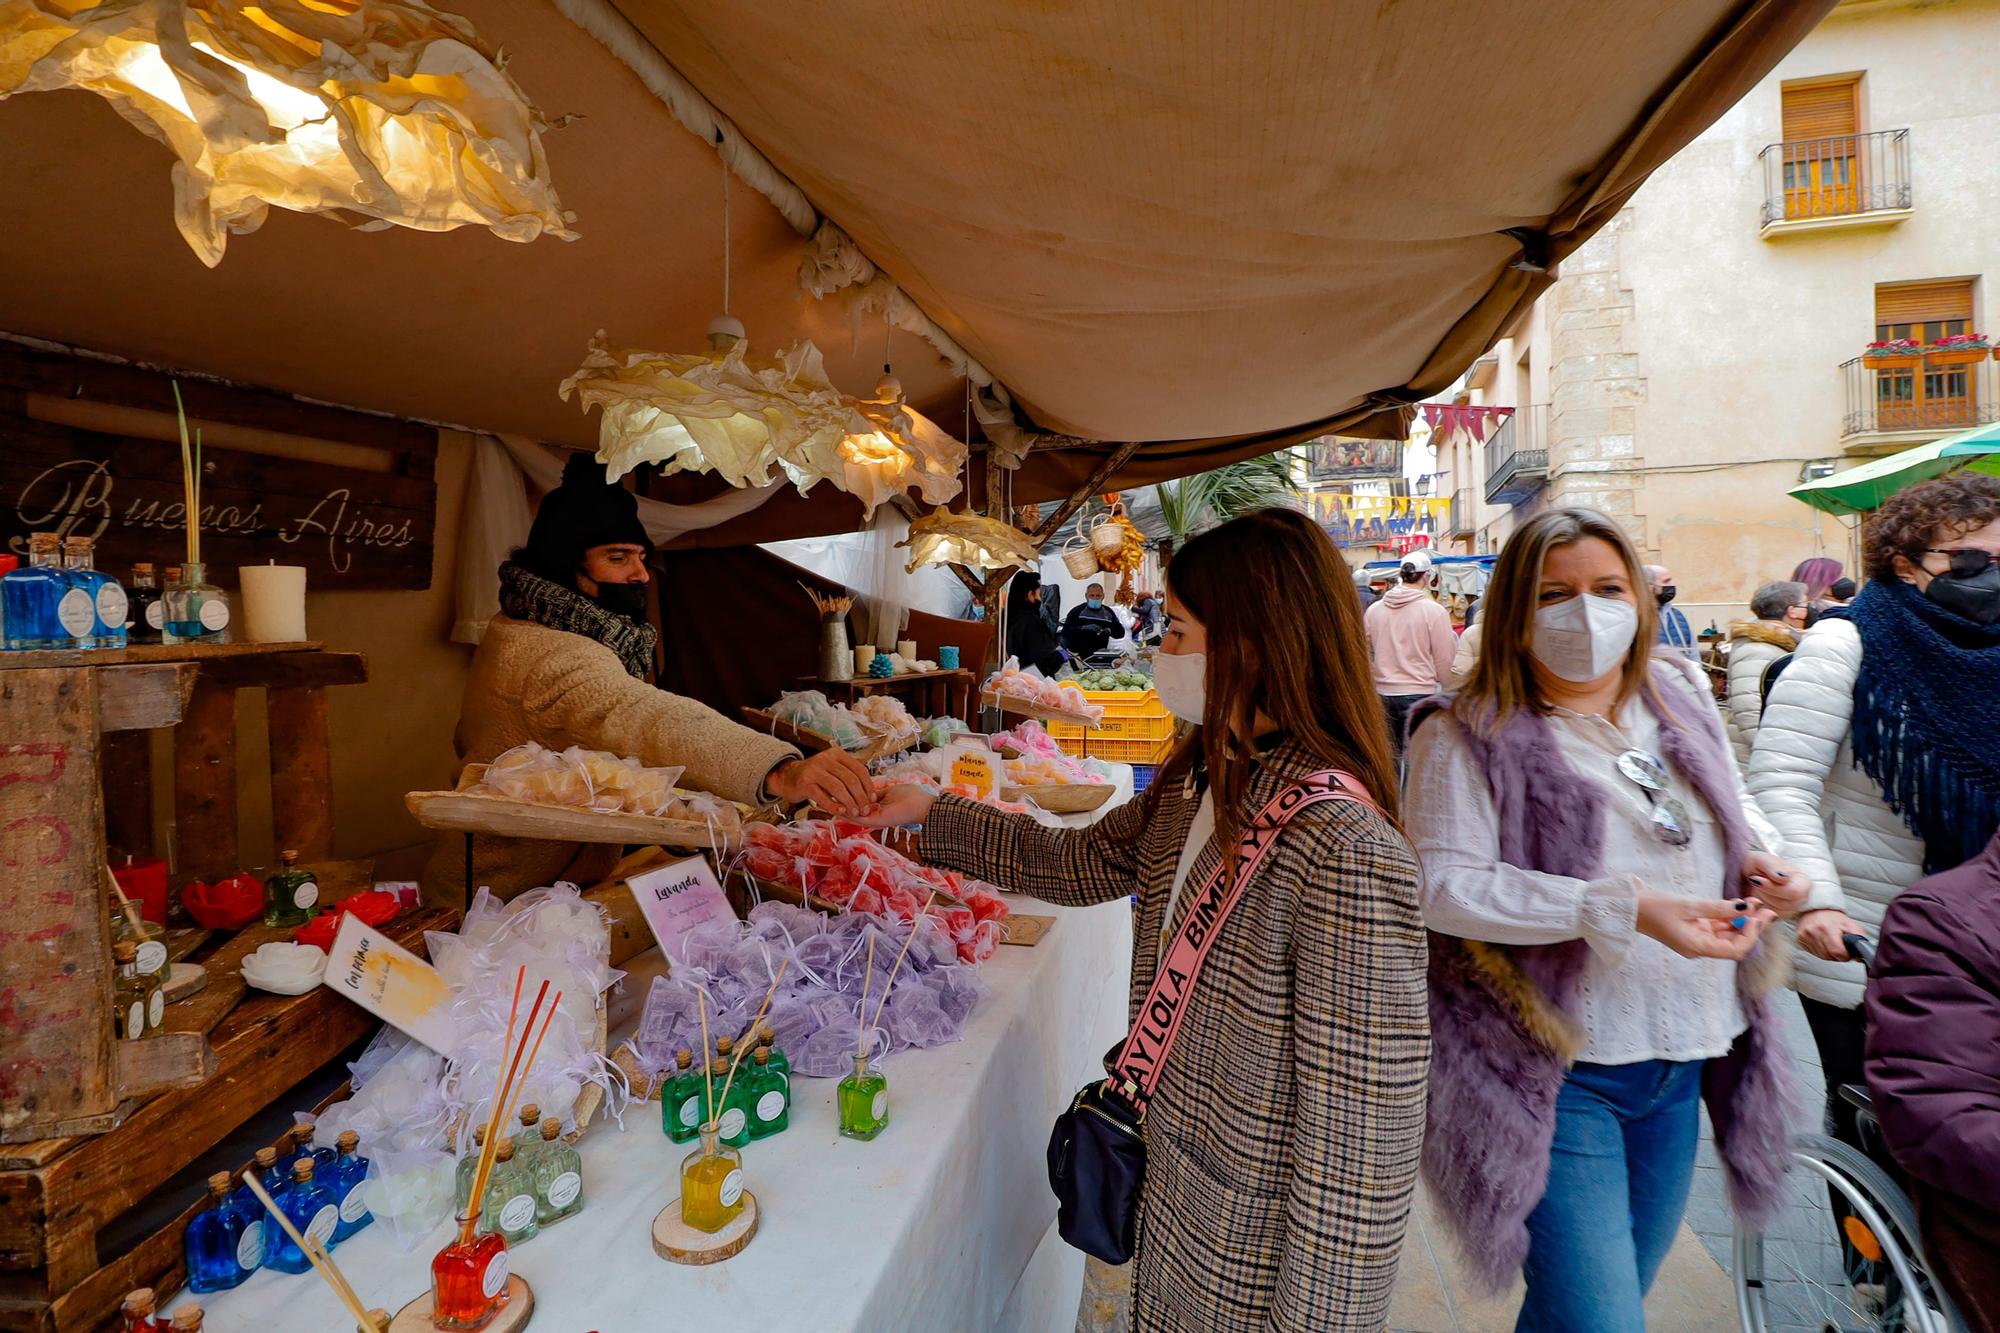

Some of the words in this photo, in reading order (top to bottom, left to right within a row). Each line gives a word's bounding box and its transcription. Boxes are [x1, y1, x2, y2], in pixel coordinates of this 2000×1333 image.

[8, 459, 264, 555] Buenos
[278, 488, 415, 574] Aires
[654, 876, 701, 901] Lavanda
[1118, 967, 1188, 1098] AYLOLA
